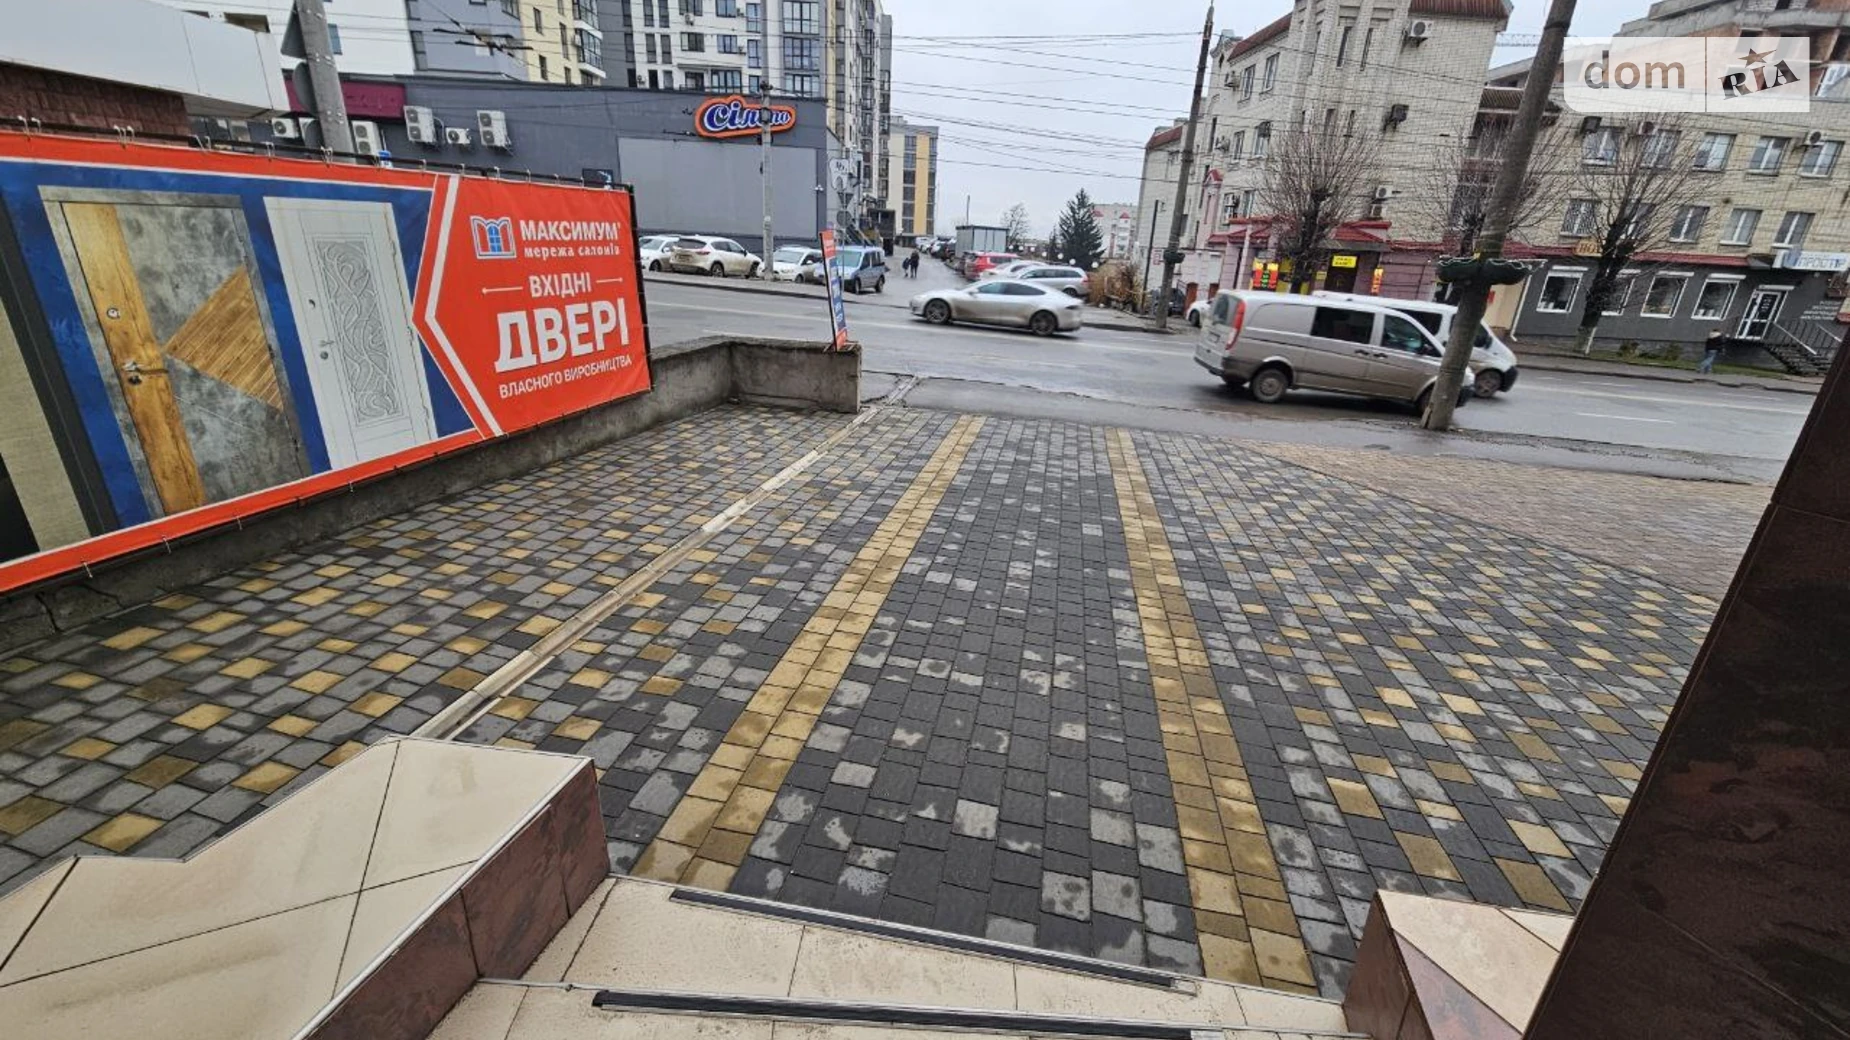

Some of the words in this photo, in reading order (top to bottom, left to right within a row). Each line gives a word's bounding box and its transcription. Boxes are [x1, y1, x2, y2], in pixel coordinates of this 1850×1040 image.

[519, 219, 619, 241] МАКСИМУМ
[524, 245, 575, 260] мережа
[579, 243, 620, 256] салонів
[528, 272, 592, 298] ВХІДНІ
[494, 298, 630, 373] ДВЕРІ
[499, 371, 563, 399] ВЛАСНОГО
[564, 354, 633, 382] ВИРОБНИЦТВА
